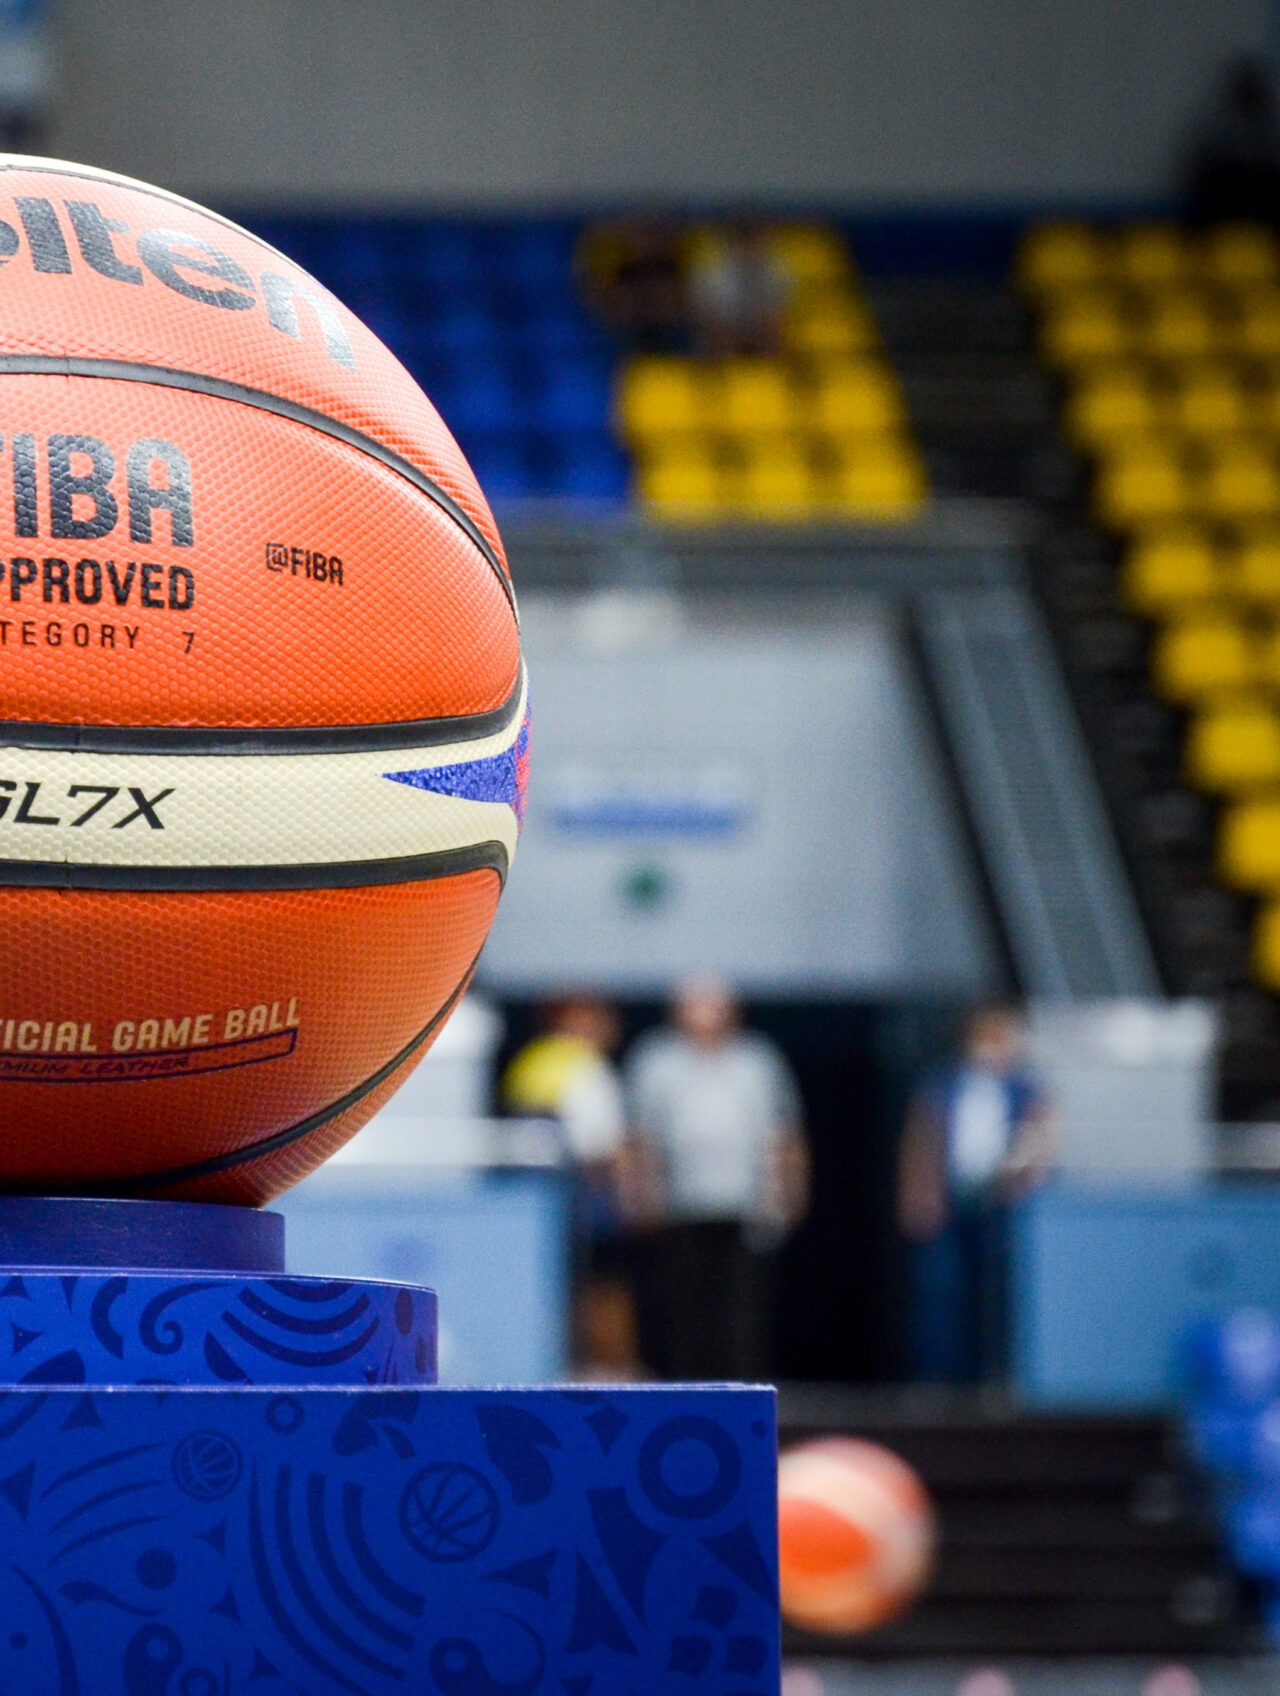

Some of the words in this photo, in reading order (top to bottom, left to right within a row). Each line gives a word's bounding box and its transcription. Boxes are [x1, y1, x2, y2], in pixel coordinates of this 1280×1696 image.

[265, 543, 344, 586] @FIBA
[182, 631, 195, 654] 7
[112, 1014, 214, 1051] GAME
[224, 997, 301, 1040] BALL
[80, 1056, 190, 1075] LEATHER
